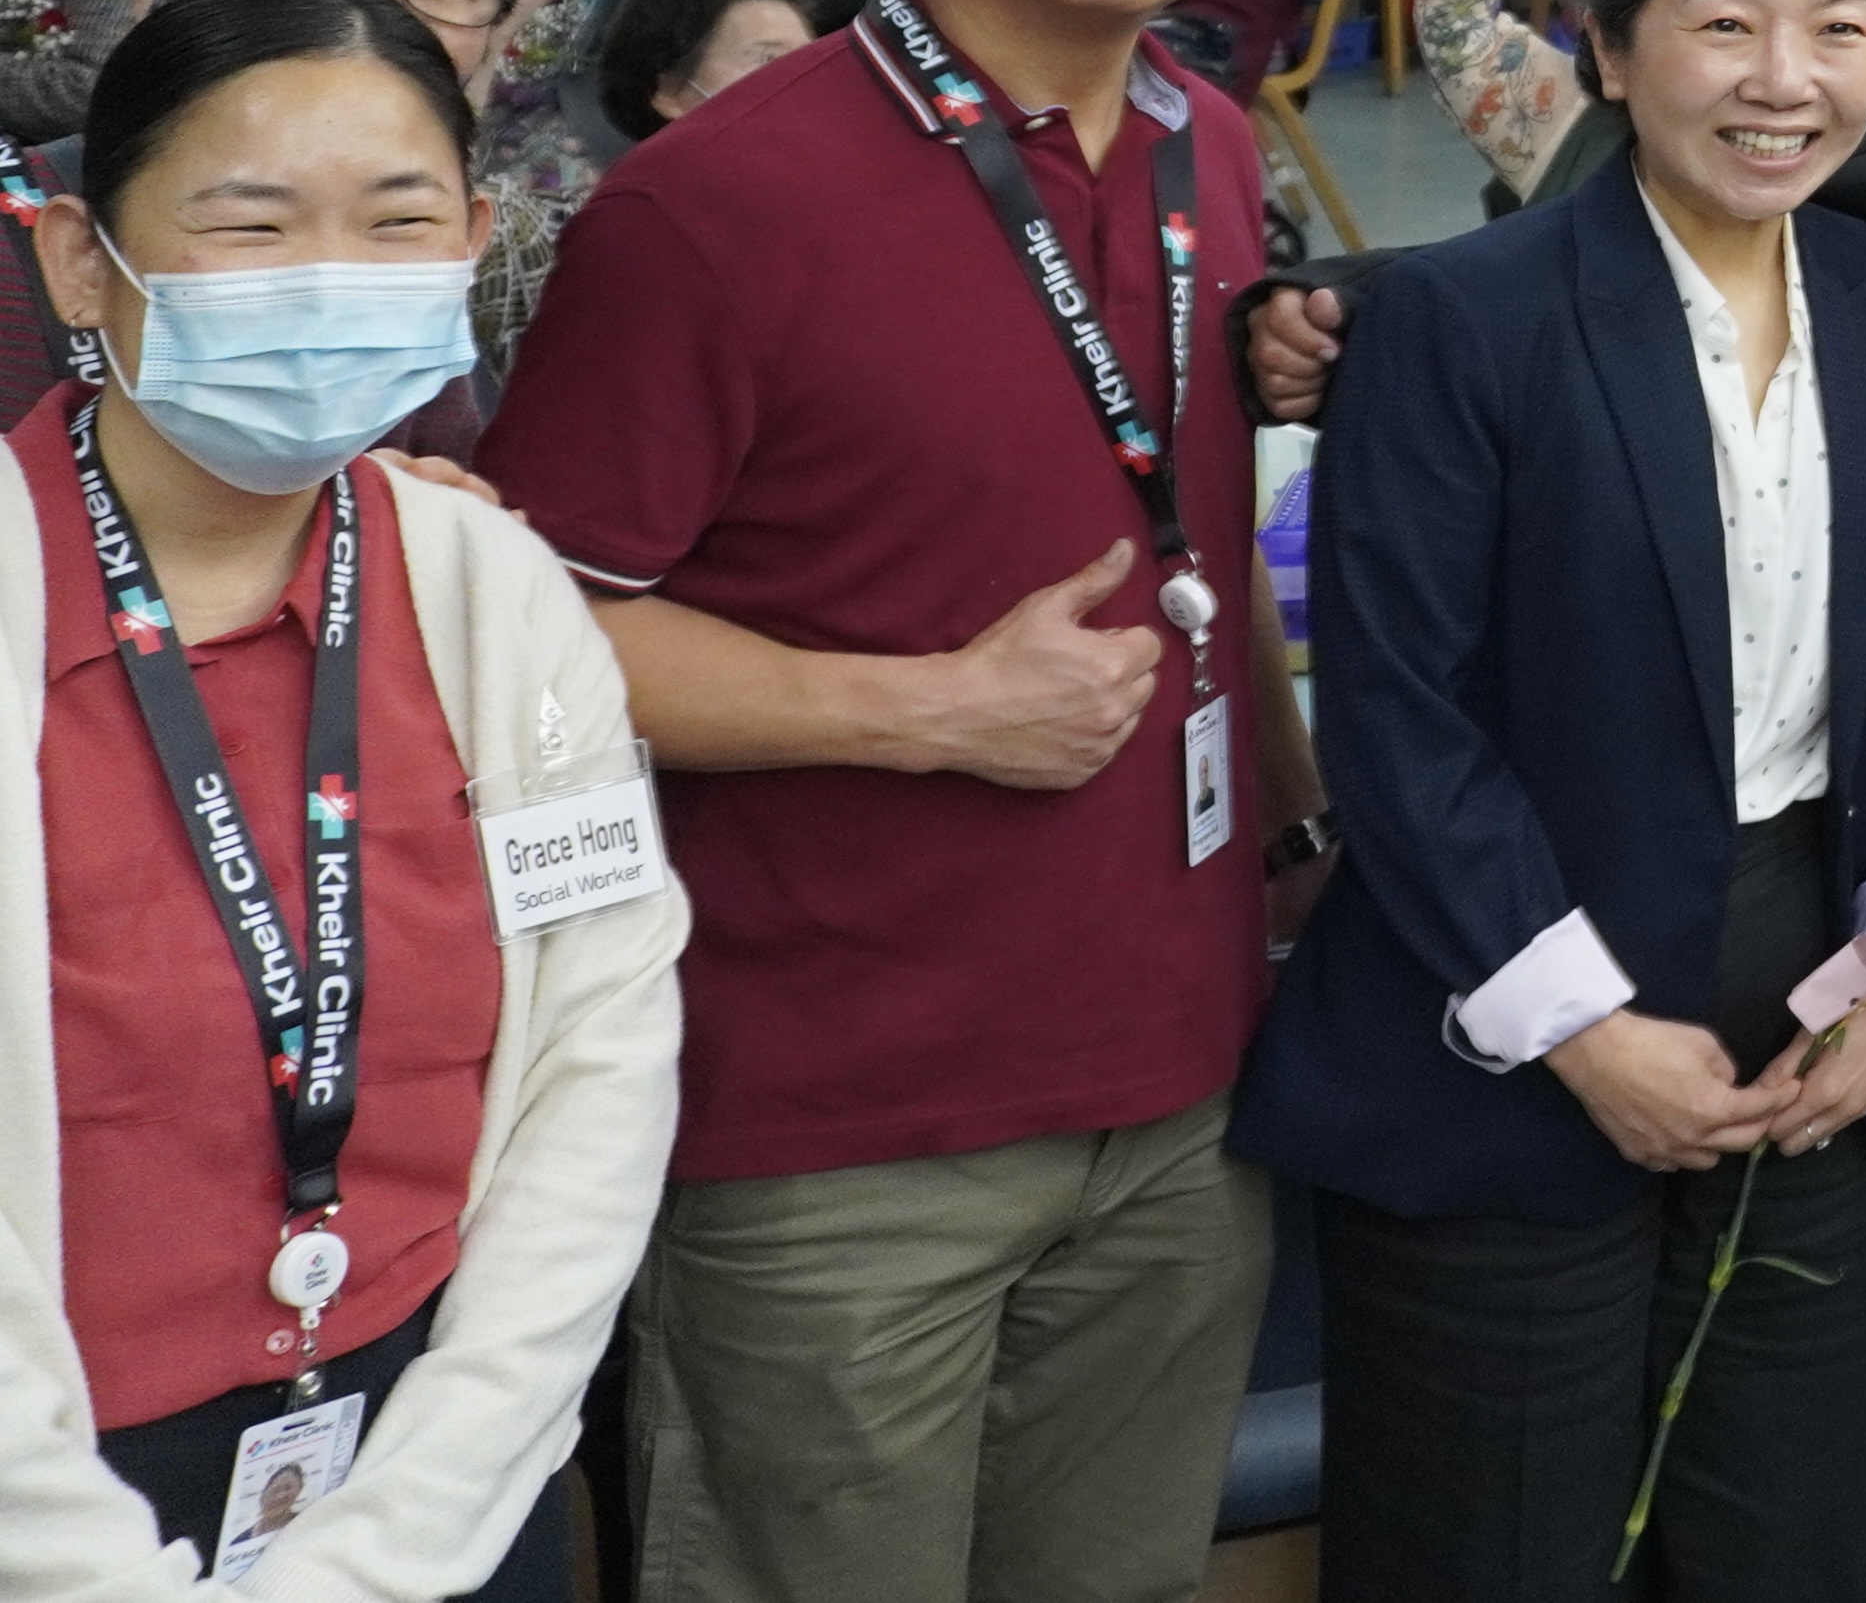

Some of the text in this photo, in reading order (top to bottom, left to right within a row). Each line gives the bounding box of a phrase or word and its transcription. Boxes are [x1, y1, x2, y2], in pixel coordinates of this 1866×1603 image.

[1025, 218, 1135, 416] Kheir Clinic
[1171, 275, 1191, 373] Kheir
[326, 467, 356, 648] eir Clinic
[195, 773, 303, 1017] Kheir Clinic
[505, 817, 639, 876] Grace Hong
[515, 862, 644, 912] Social Worker
[307, 852, 352, 1107] Kheir Clinic
